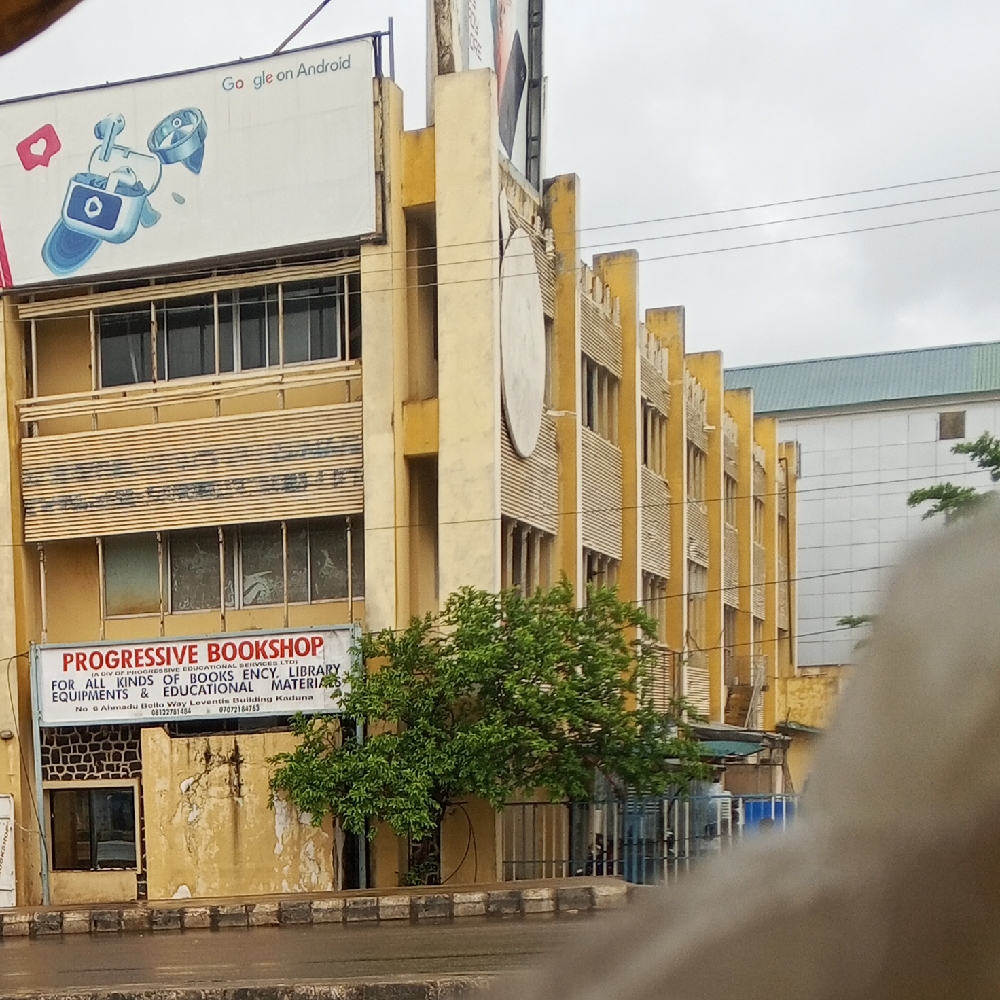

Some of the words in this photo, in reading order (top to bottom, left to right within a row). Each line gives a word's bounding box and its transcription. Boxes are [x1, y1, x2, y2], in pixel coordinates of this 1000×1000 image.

[222, 70, 273, 91] Gogle
[276, 69, 293, 82] on
[296, 54, 351, 78] Android
[62, 644, 198, 672] PROGRESSIVE
[207, 636, 324, 663] BOOKSHOP
[182, 663, 237, 672] EDUCATIONAL
[239, 660, 278, 668] SERVICES
[51, 680, 75, 691] FOR
[85, 678, 106, 689] ALL
[117, 674, 154, 689] KINDS
[163, 674, 180, 686] OF
[190, 670, 234, 684] BOOKS
[289, 663, 341, 678] LIBRARY
[52, 688, 129, 703] EQUIPMENTS
[140, 687, 149, 699] &
[163, 682, 254, 697] EDUCATIONAL
[166, 700, 187, 709] Way
